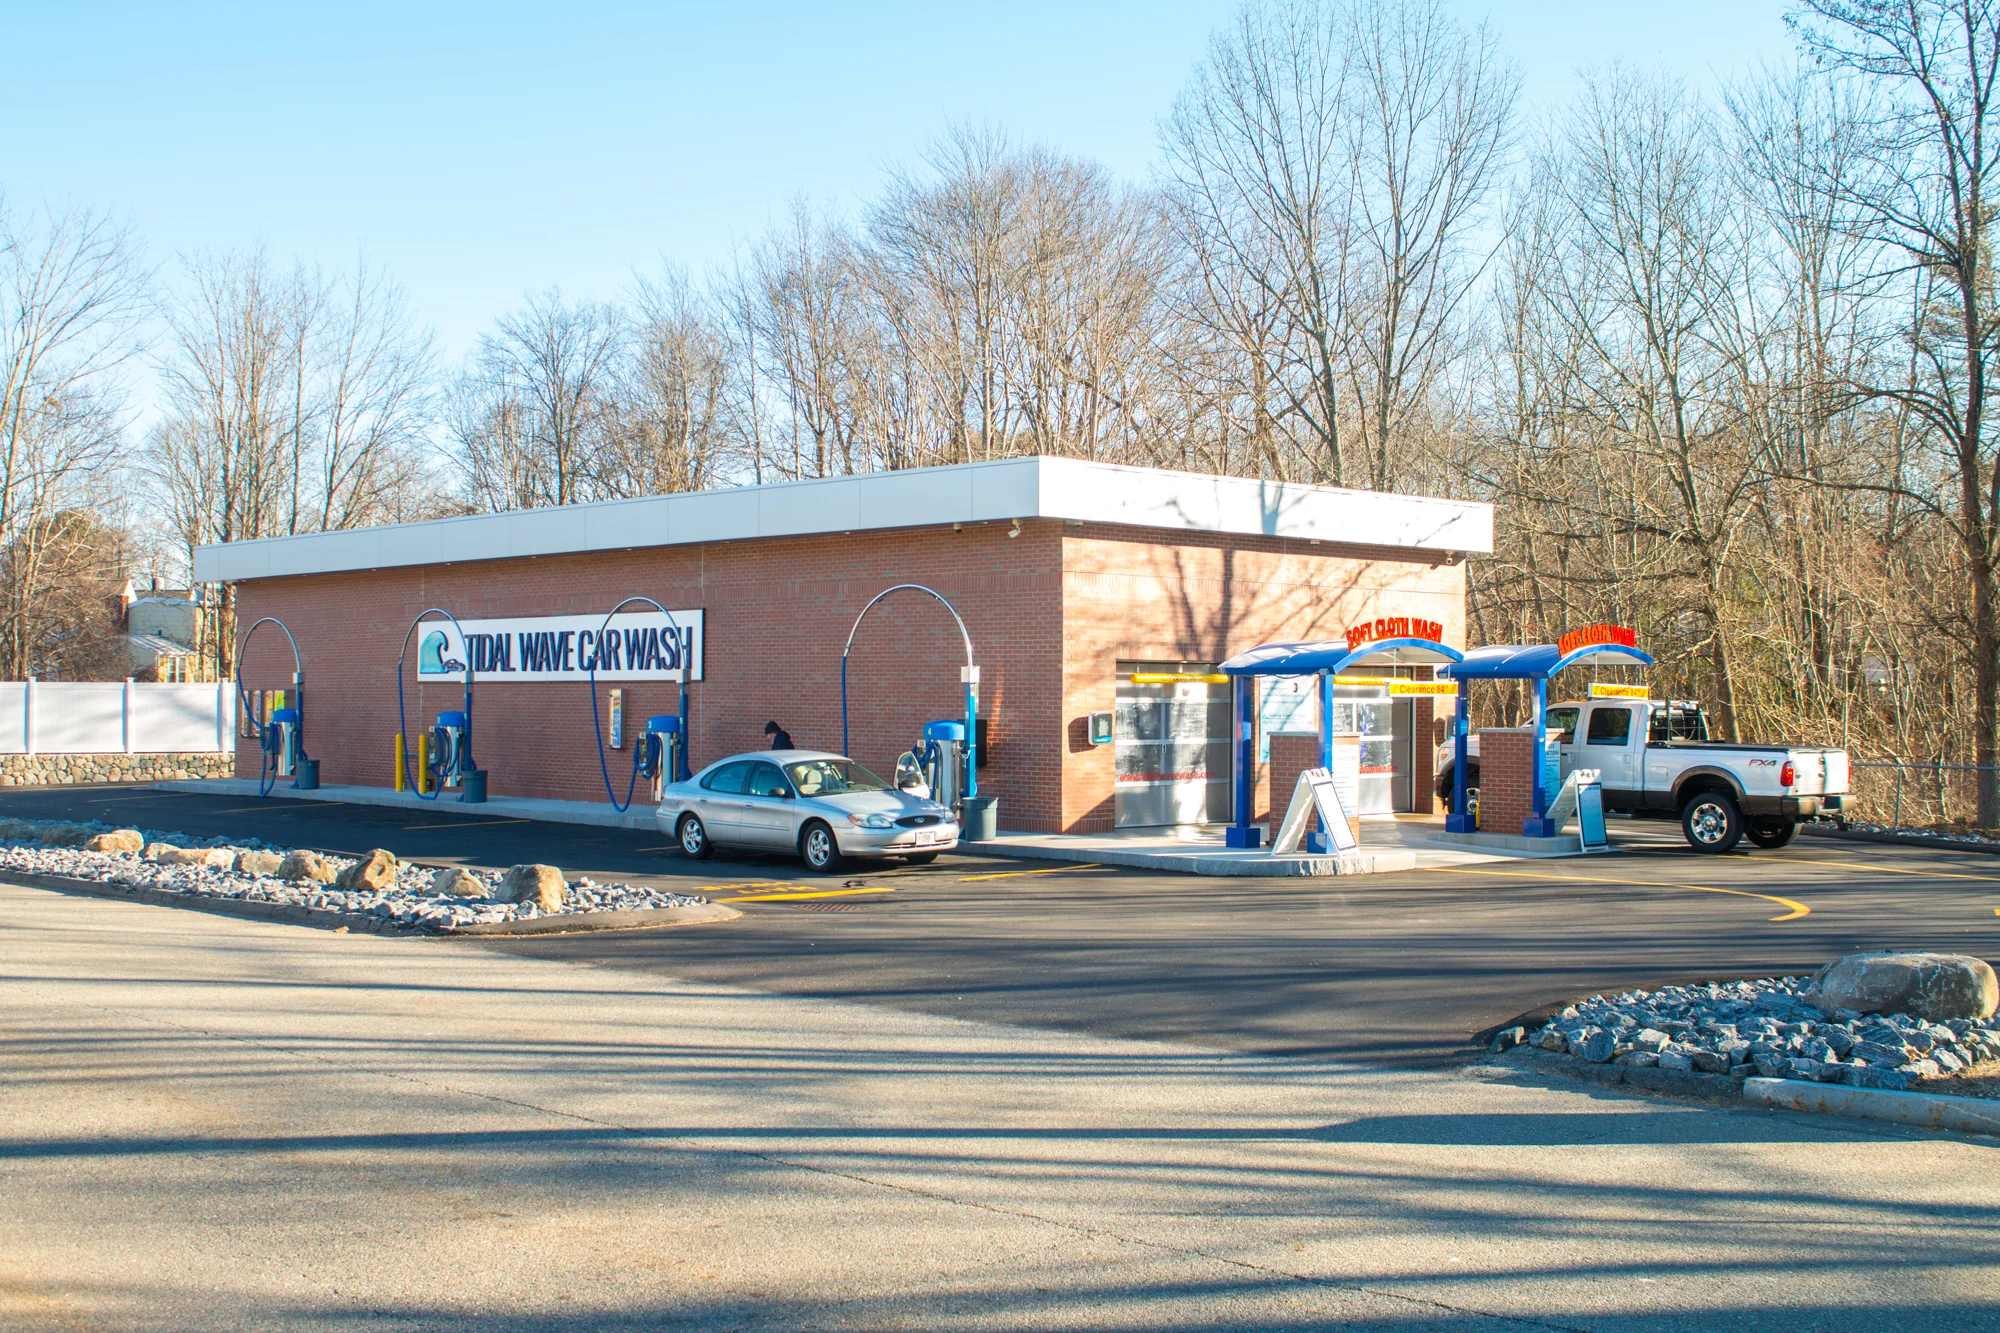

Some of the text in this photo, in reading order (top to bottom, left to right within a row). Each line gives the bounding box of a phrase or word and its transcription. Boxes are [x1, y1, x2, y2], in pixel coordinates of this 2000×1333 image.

[1346, 617, 1443, 650] SOFT CLOTH WASH
[1558, 629, 1581, 656] SOFT
[1581, 624, 1610, 645] CLOTH
[464, 626, 693, 672] TIDAL WAVE CAR WASH
[1399, 684, 1435, 694] Clearance
[1600, 686, 1629, 696] Clearance
[927, 727, 932, 736] 4
[1748, 758, 1777, 767] FX4
